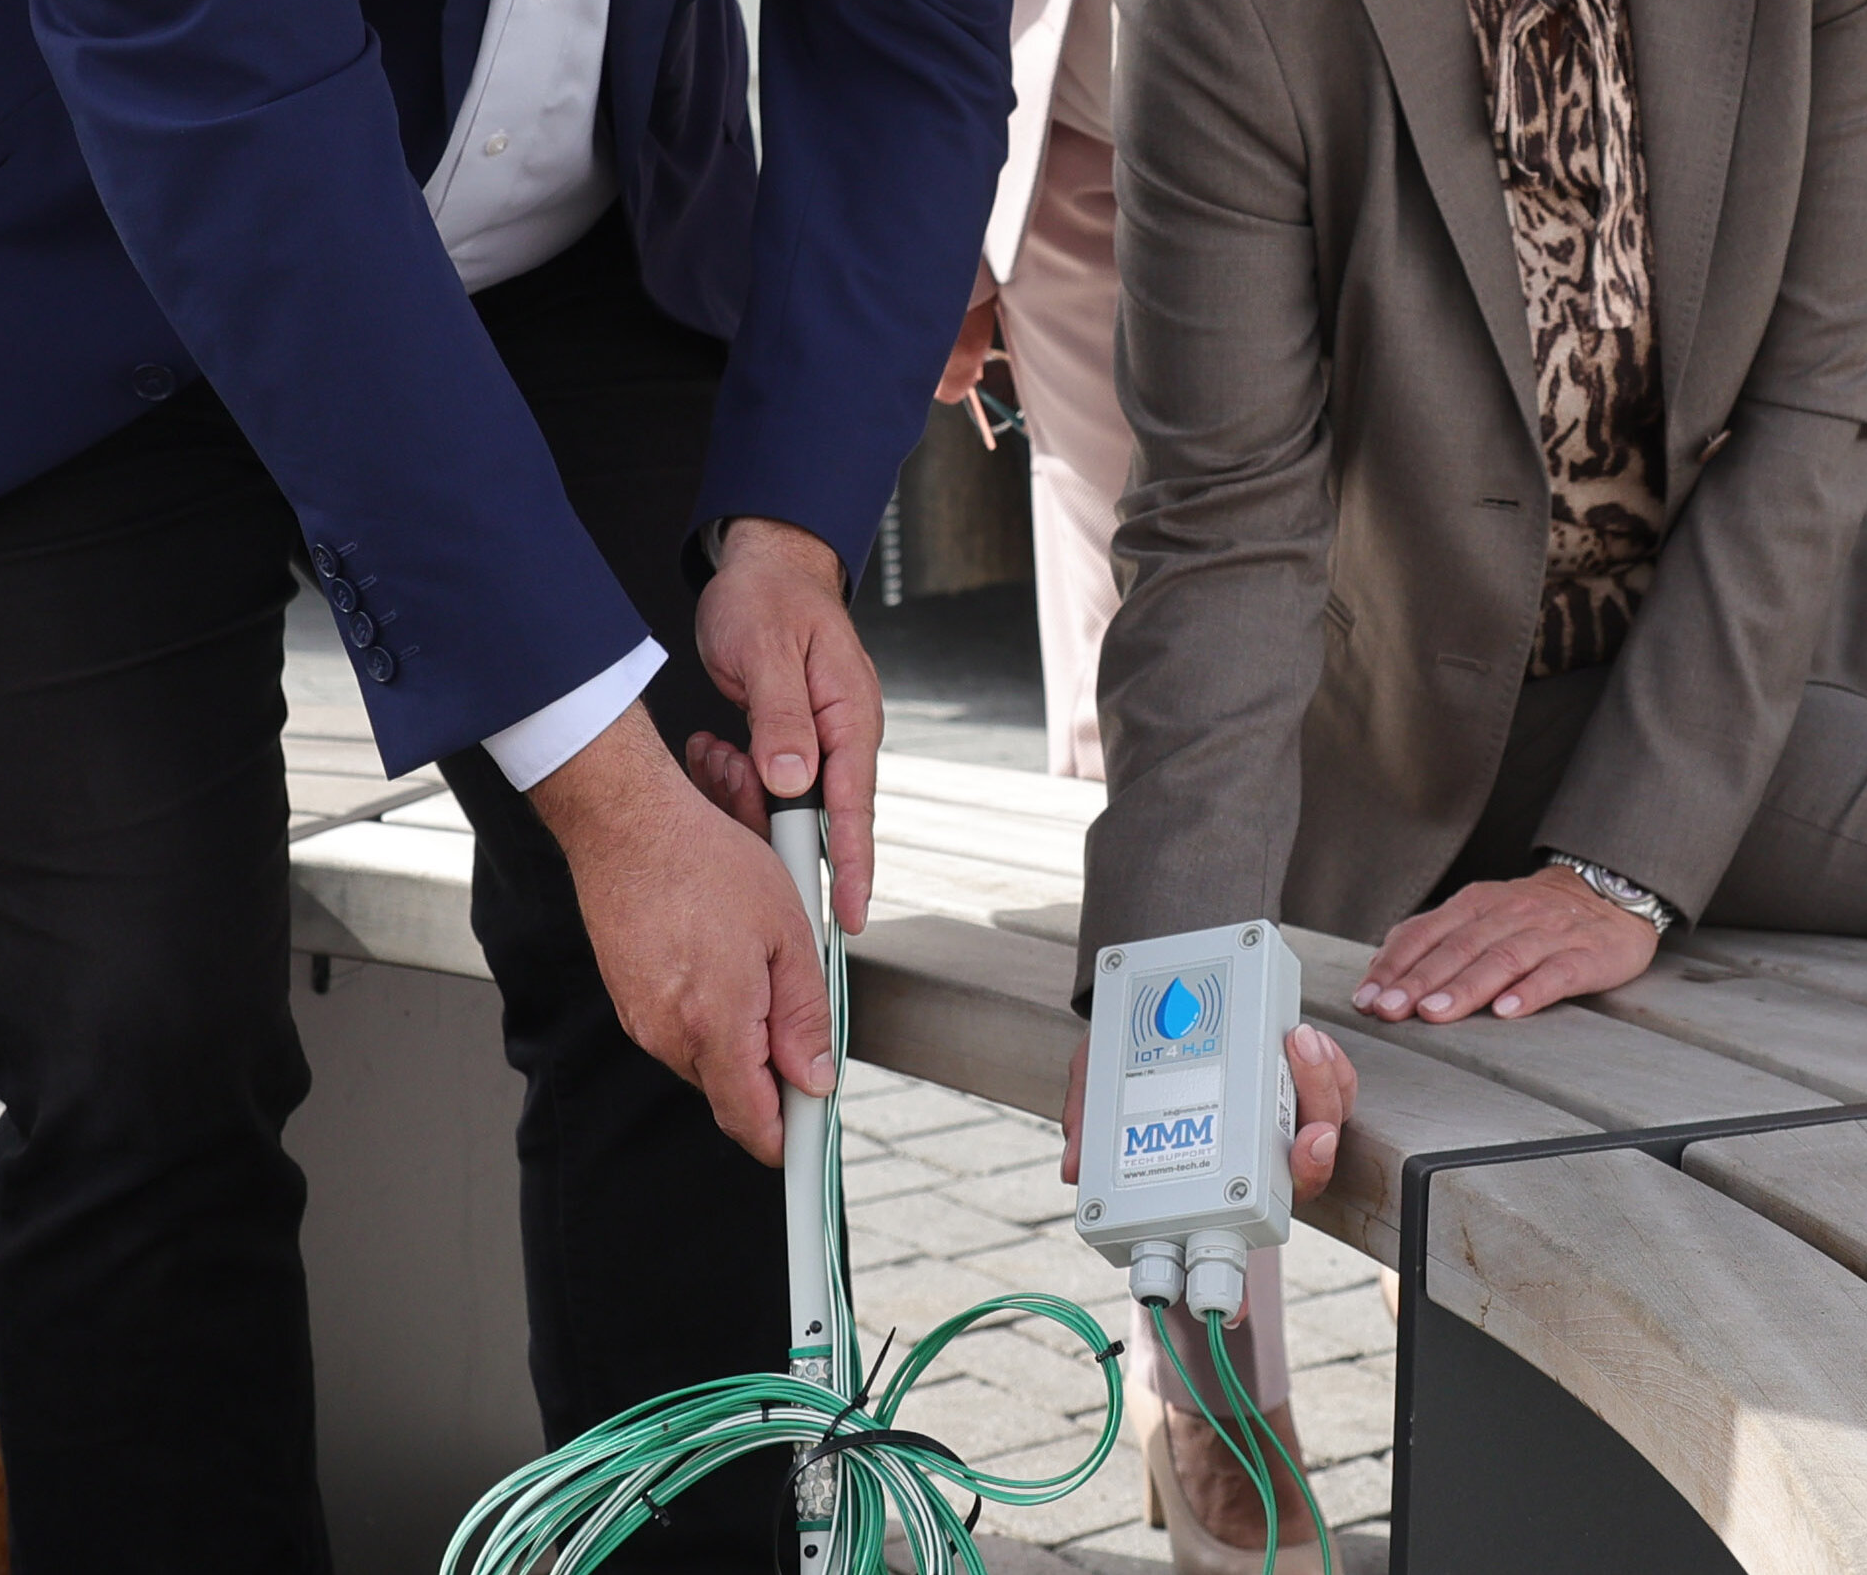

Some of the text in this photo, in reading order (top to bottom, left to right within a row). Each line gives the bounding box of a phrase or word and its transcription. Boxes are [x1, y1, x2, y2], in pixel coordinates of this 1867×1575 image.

[1166, 1044, 1178, 1057] 4
[1124, 1114, 1214, 1157] MMM
[1123, 1147, 1213, 1167] TECH SUPPORT
[1123, 1160, 1211, 1180] www.mmm-tech.de
